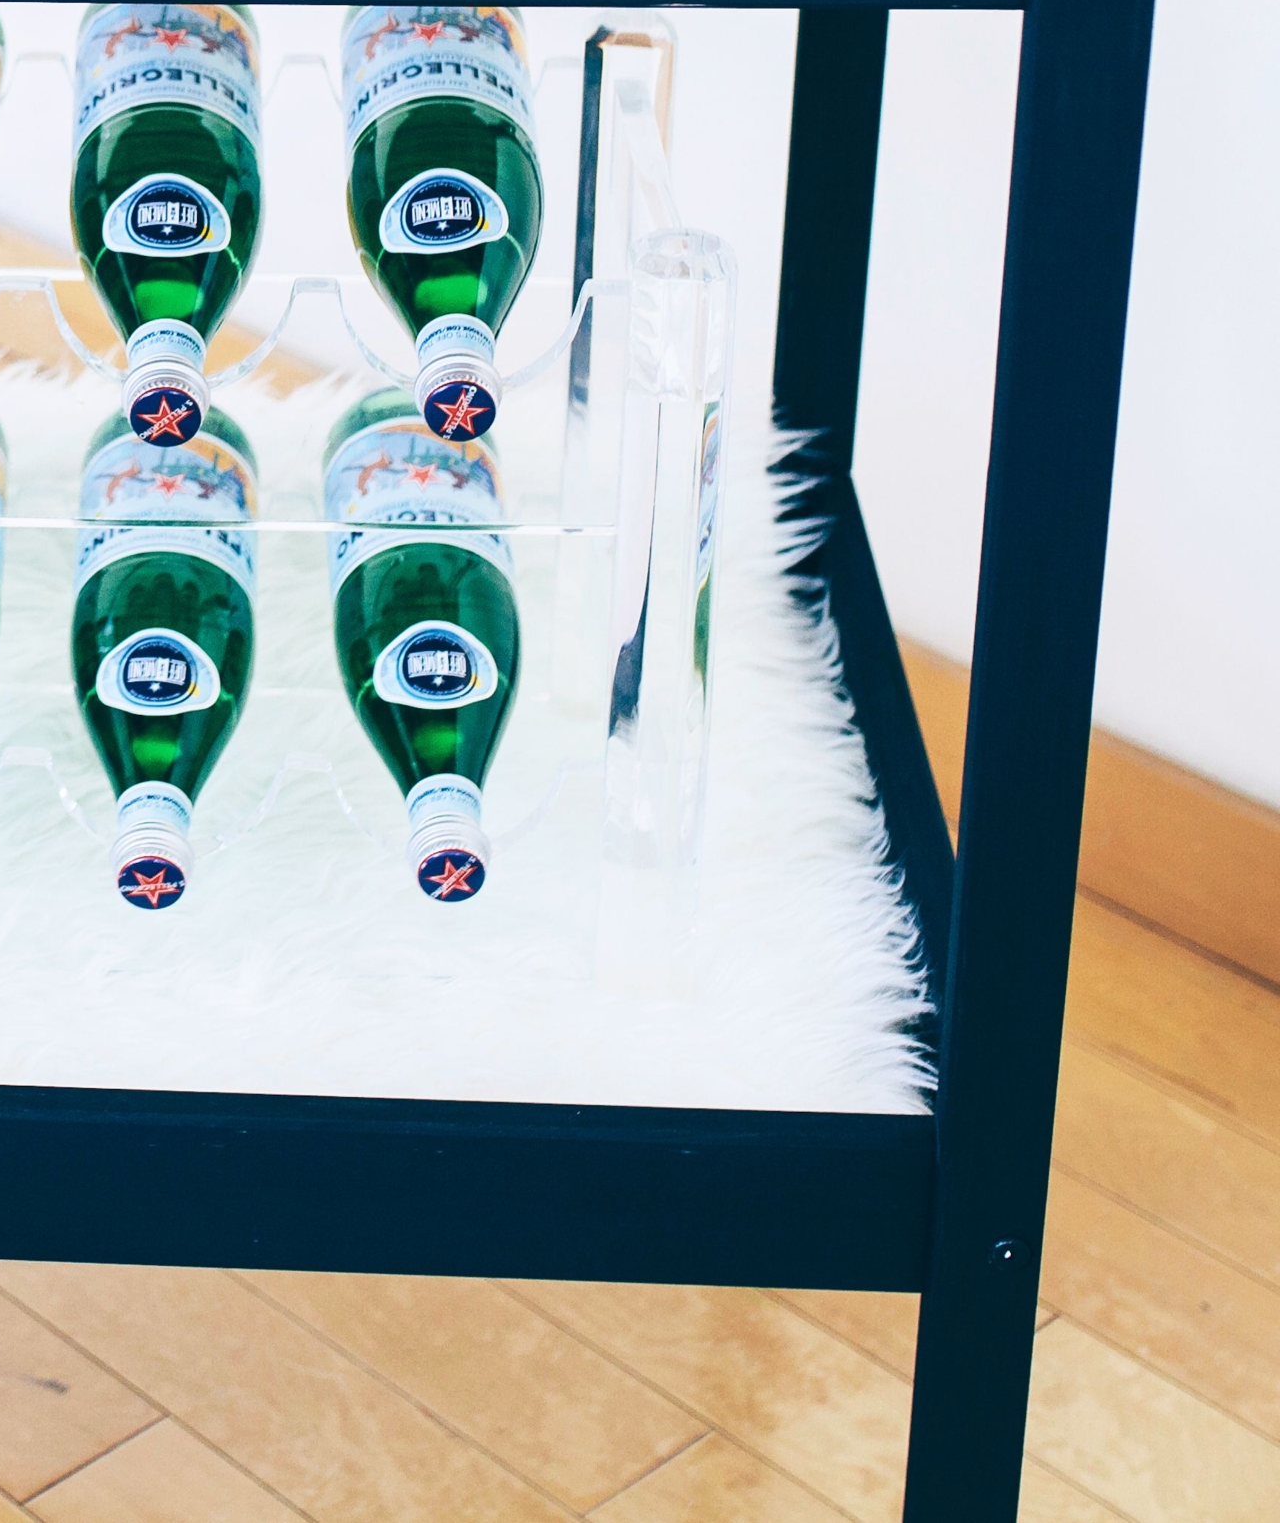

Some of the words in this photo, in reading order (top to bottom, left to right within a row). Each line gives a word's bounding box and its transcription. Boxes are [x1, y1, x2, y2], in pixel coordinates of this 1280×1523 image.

[137, 204, 167, 225] MENU
[181, 205, 197, 225] OFF
[412, 201, 440, 223] MENU
[454, 199, 472, 218] OFF
